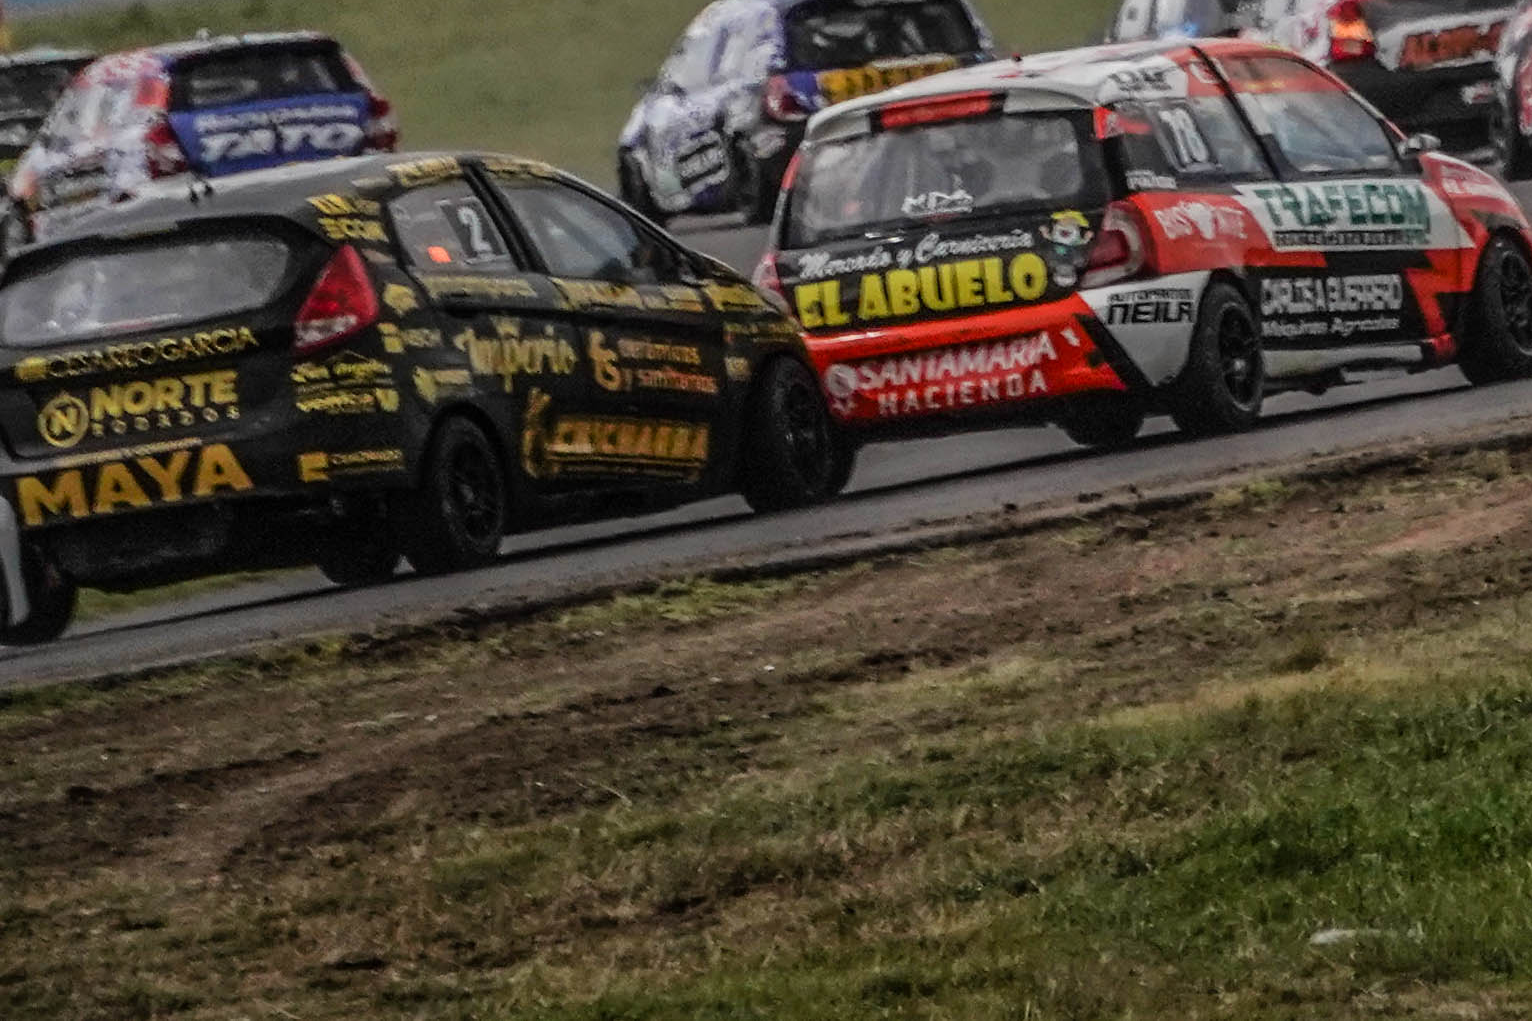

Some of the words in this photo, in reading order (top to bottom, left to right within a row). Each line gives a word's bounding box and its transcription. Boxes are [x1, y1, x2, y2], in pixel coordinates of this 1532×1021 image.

[457, 206, 492, 254] 2
[795, 279, 850, 329] EL
[858, 253, 1047, 321] ABUELO
[90, 369, 239, 421] NORTE
[877, 371, 1049, 415] HACIENDA
[16, 443, 254, 527] MAYA
